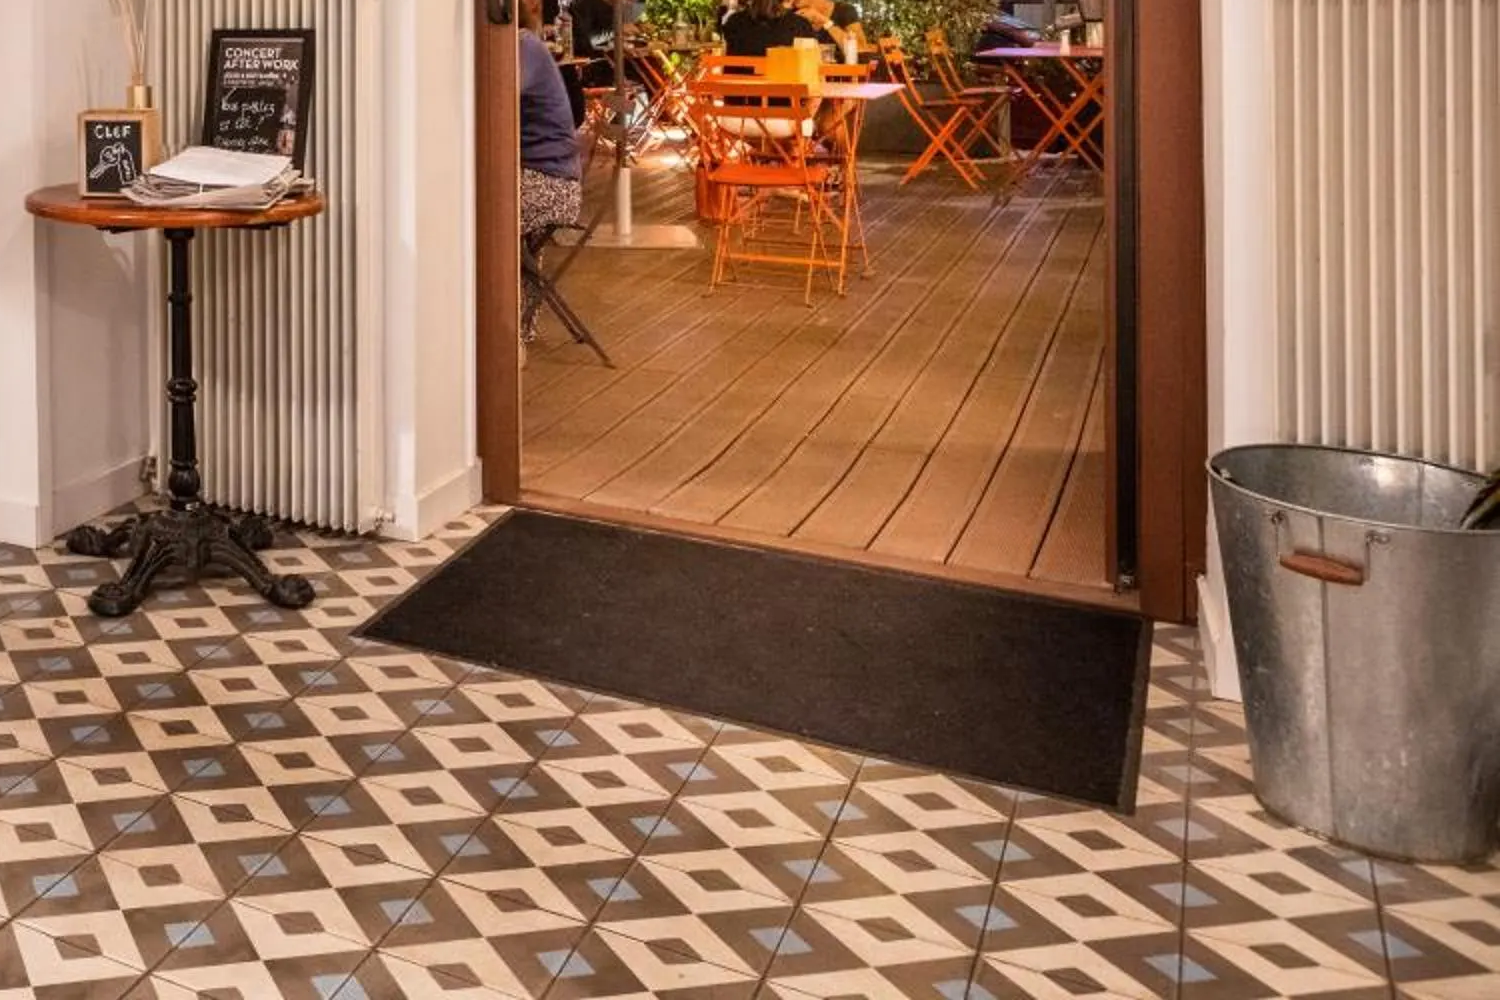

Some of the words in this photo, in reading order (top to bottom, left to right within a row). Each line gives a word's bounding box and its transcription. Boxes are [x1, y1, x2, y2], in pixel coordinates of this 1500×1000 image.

[225, 47, 282, 59] CONCERT
[223, 59, 260, 70] AFTER
[262, 59, 299, 71] WORK
[94, 124, 132, 139] CLEF
